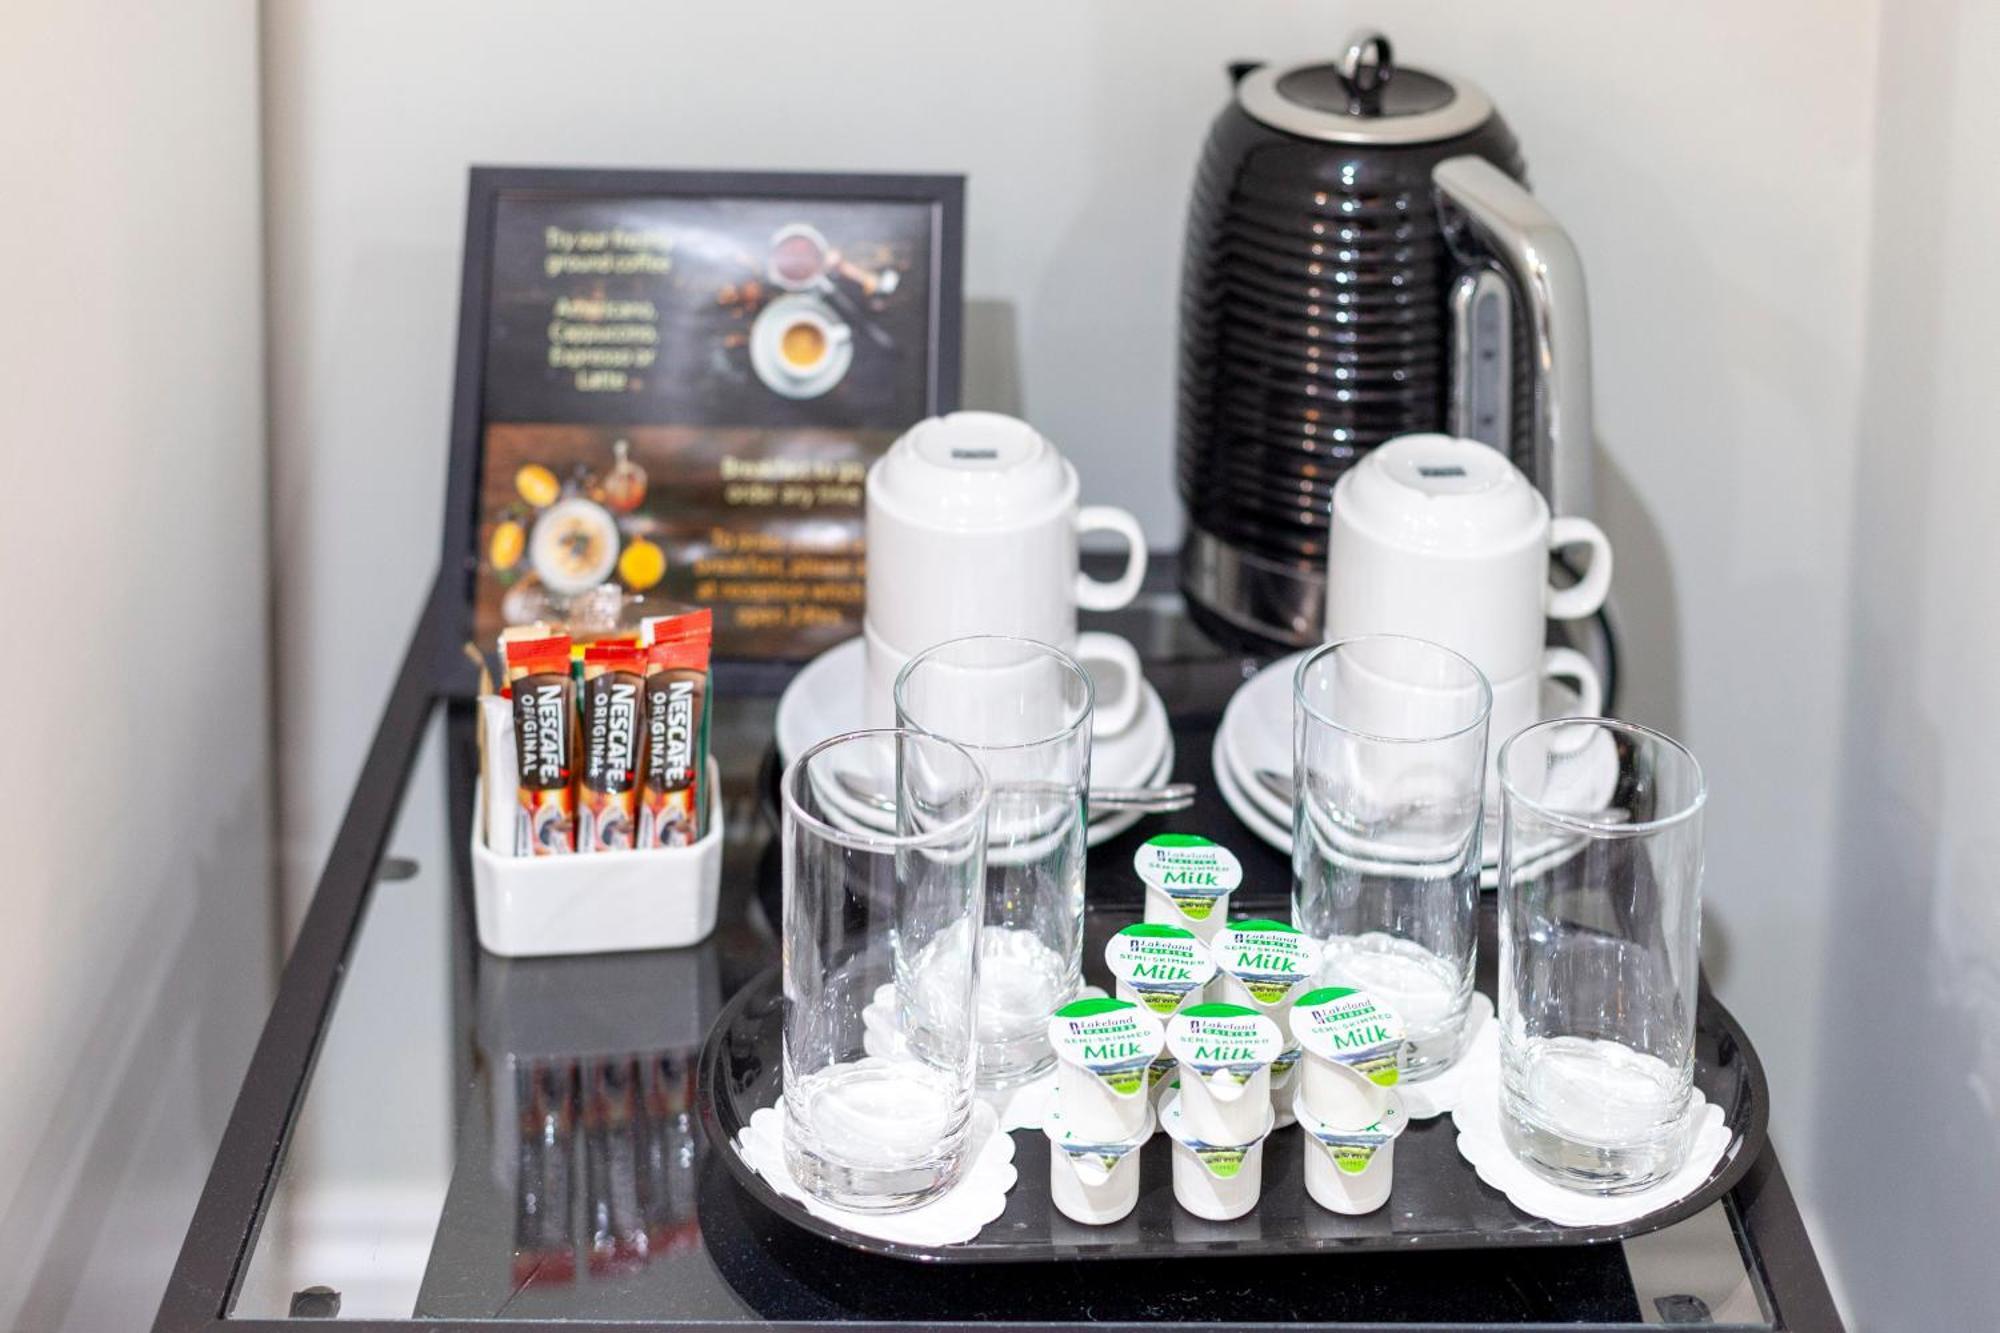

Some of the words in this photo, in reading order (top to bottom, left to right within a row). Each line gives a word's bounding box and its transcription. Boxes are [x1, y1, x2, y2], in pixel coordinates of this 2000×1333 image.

[651, 691, 666, 775] ORIGINAL
[1164, 872, 1218, 887] Milk
[1140, 940, 1194, 952] Lakeland
[1237, 952, 1297, 973] Milk
[1133, 963, 1192, 980] Milk
[1080, 1016, 1133, 1028] Lakeland
[1333, 1025, 1393, 1050] Milk
[1084, 1042, 1142, 1059] Milk
[1195, 1046, 1256, 1060] Milk
